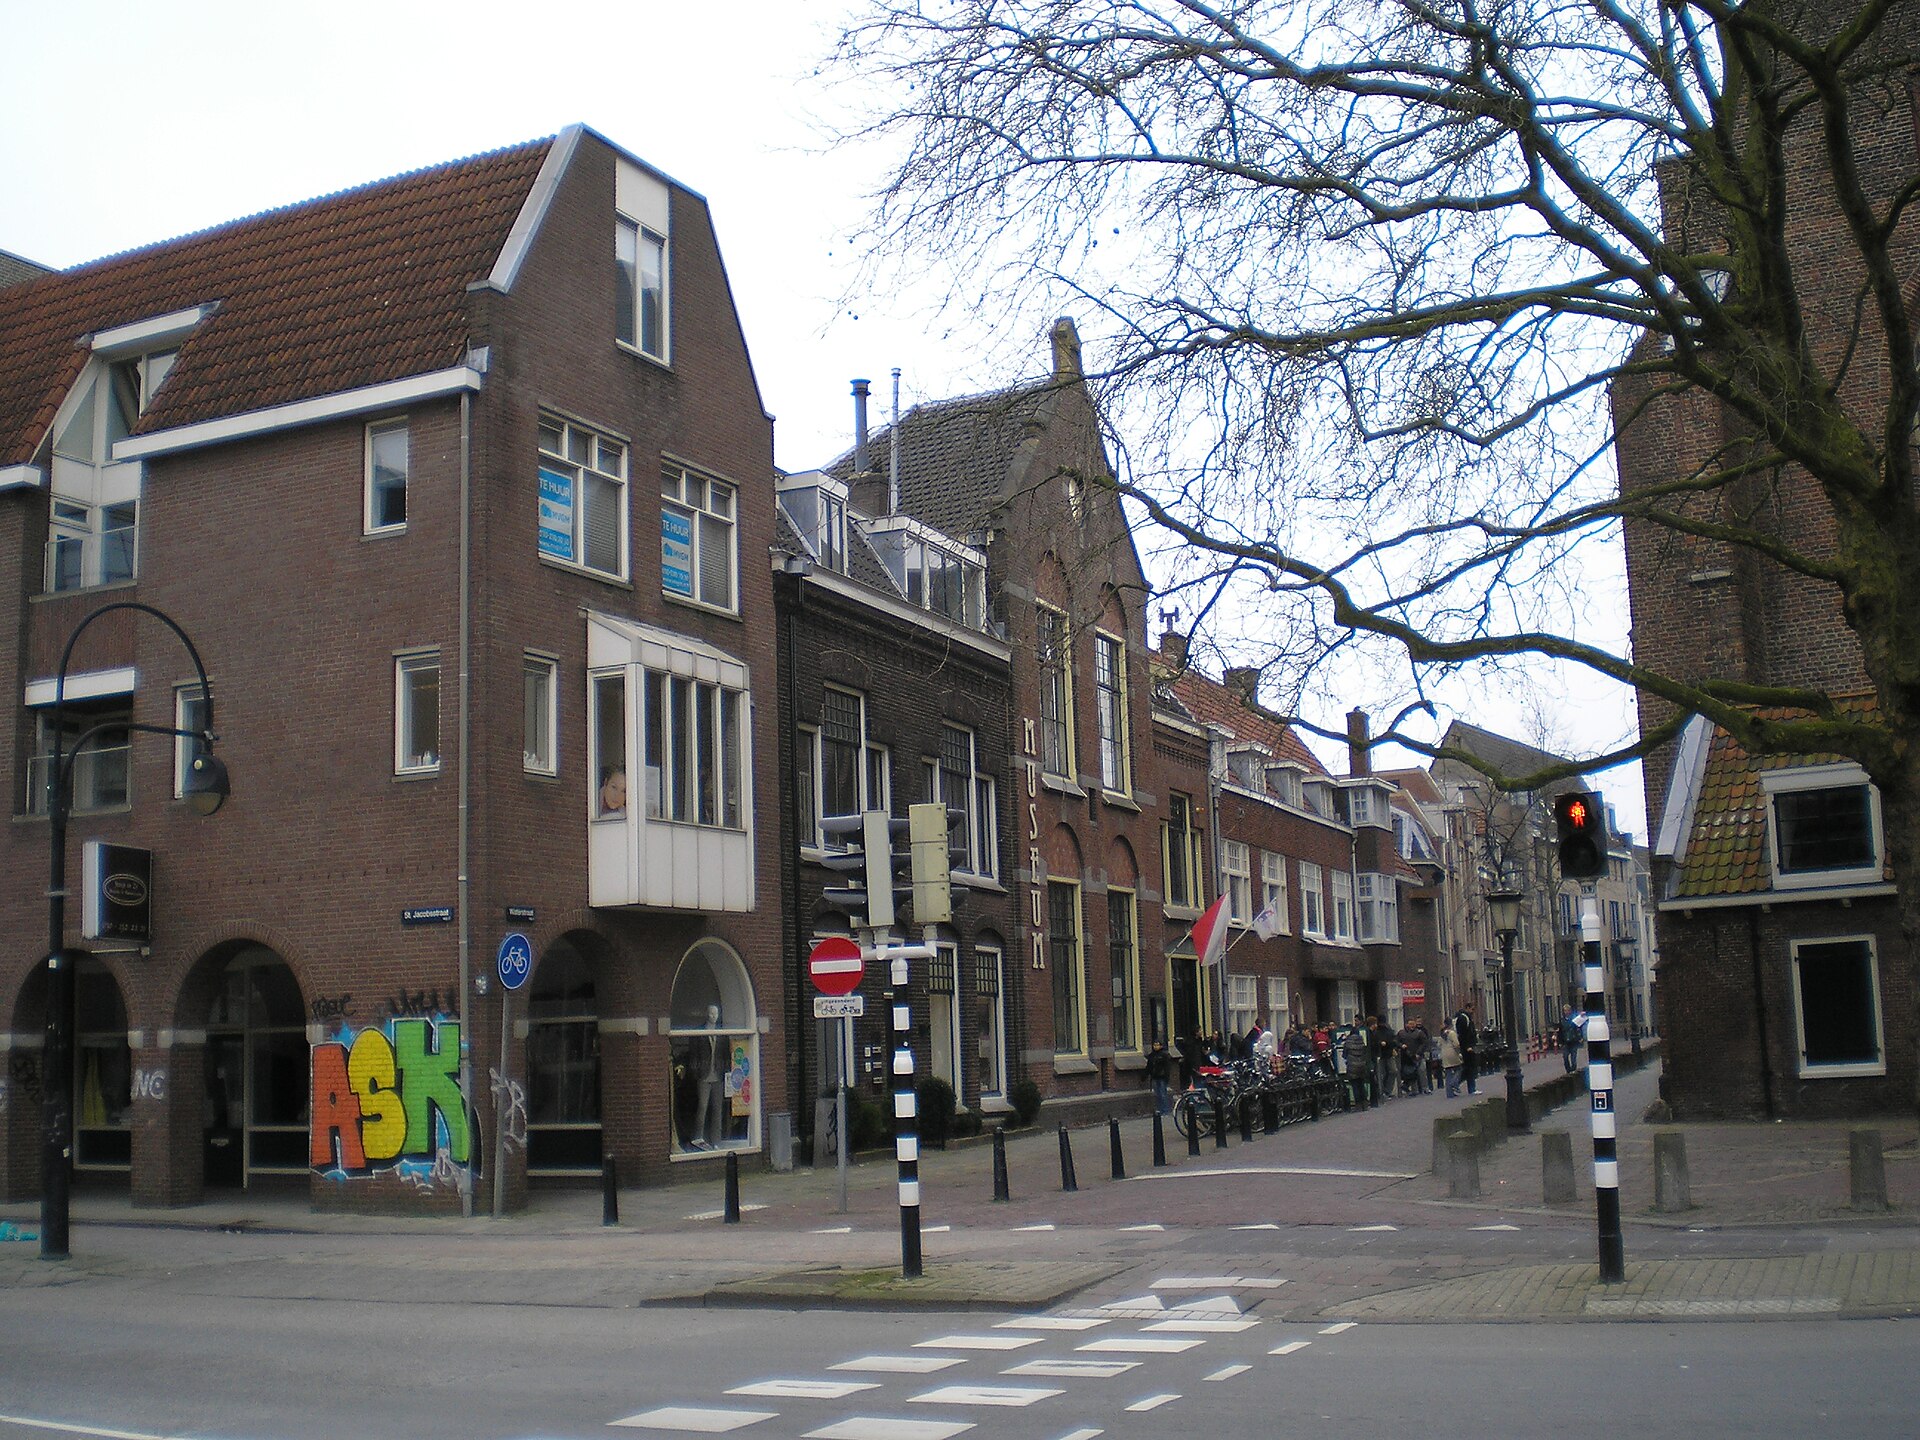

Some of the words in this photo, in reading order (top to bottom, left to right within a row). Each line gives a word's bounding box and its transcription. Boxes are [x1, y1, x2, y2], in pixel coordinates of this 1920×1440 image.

[539, 478, 548, 490] TE
[549, 483, 570, 498] HUUR
[662, 520, 670, 531] TE
[670, 523, 689, 538] HUUR
[1024, 718, 1046, 969] MUSEUM
[310, 1018, 472, 1173] ASK
